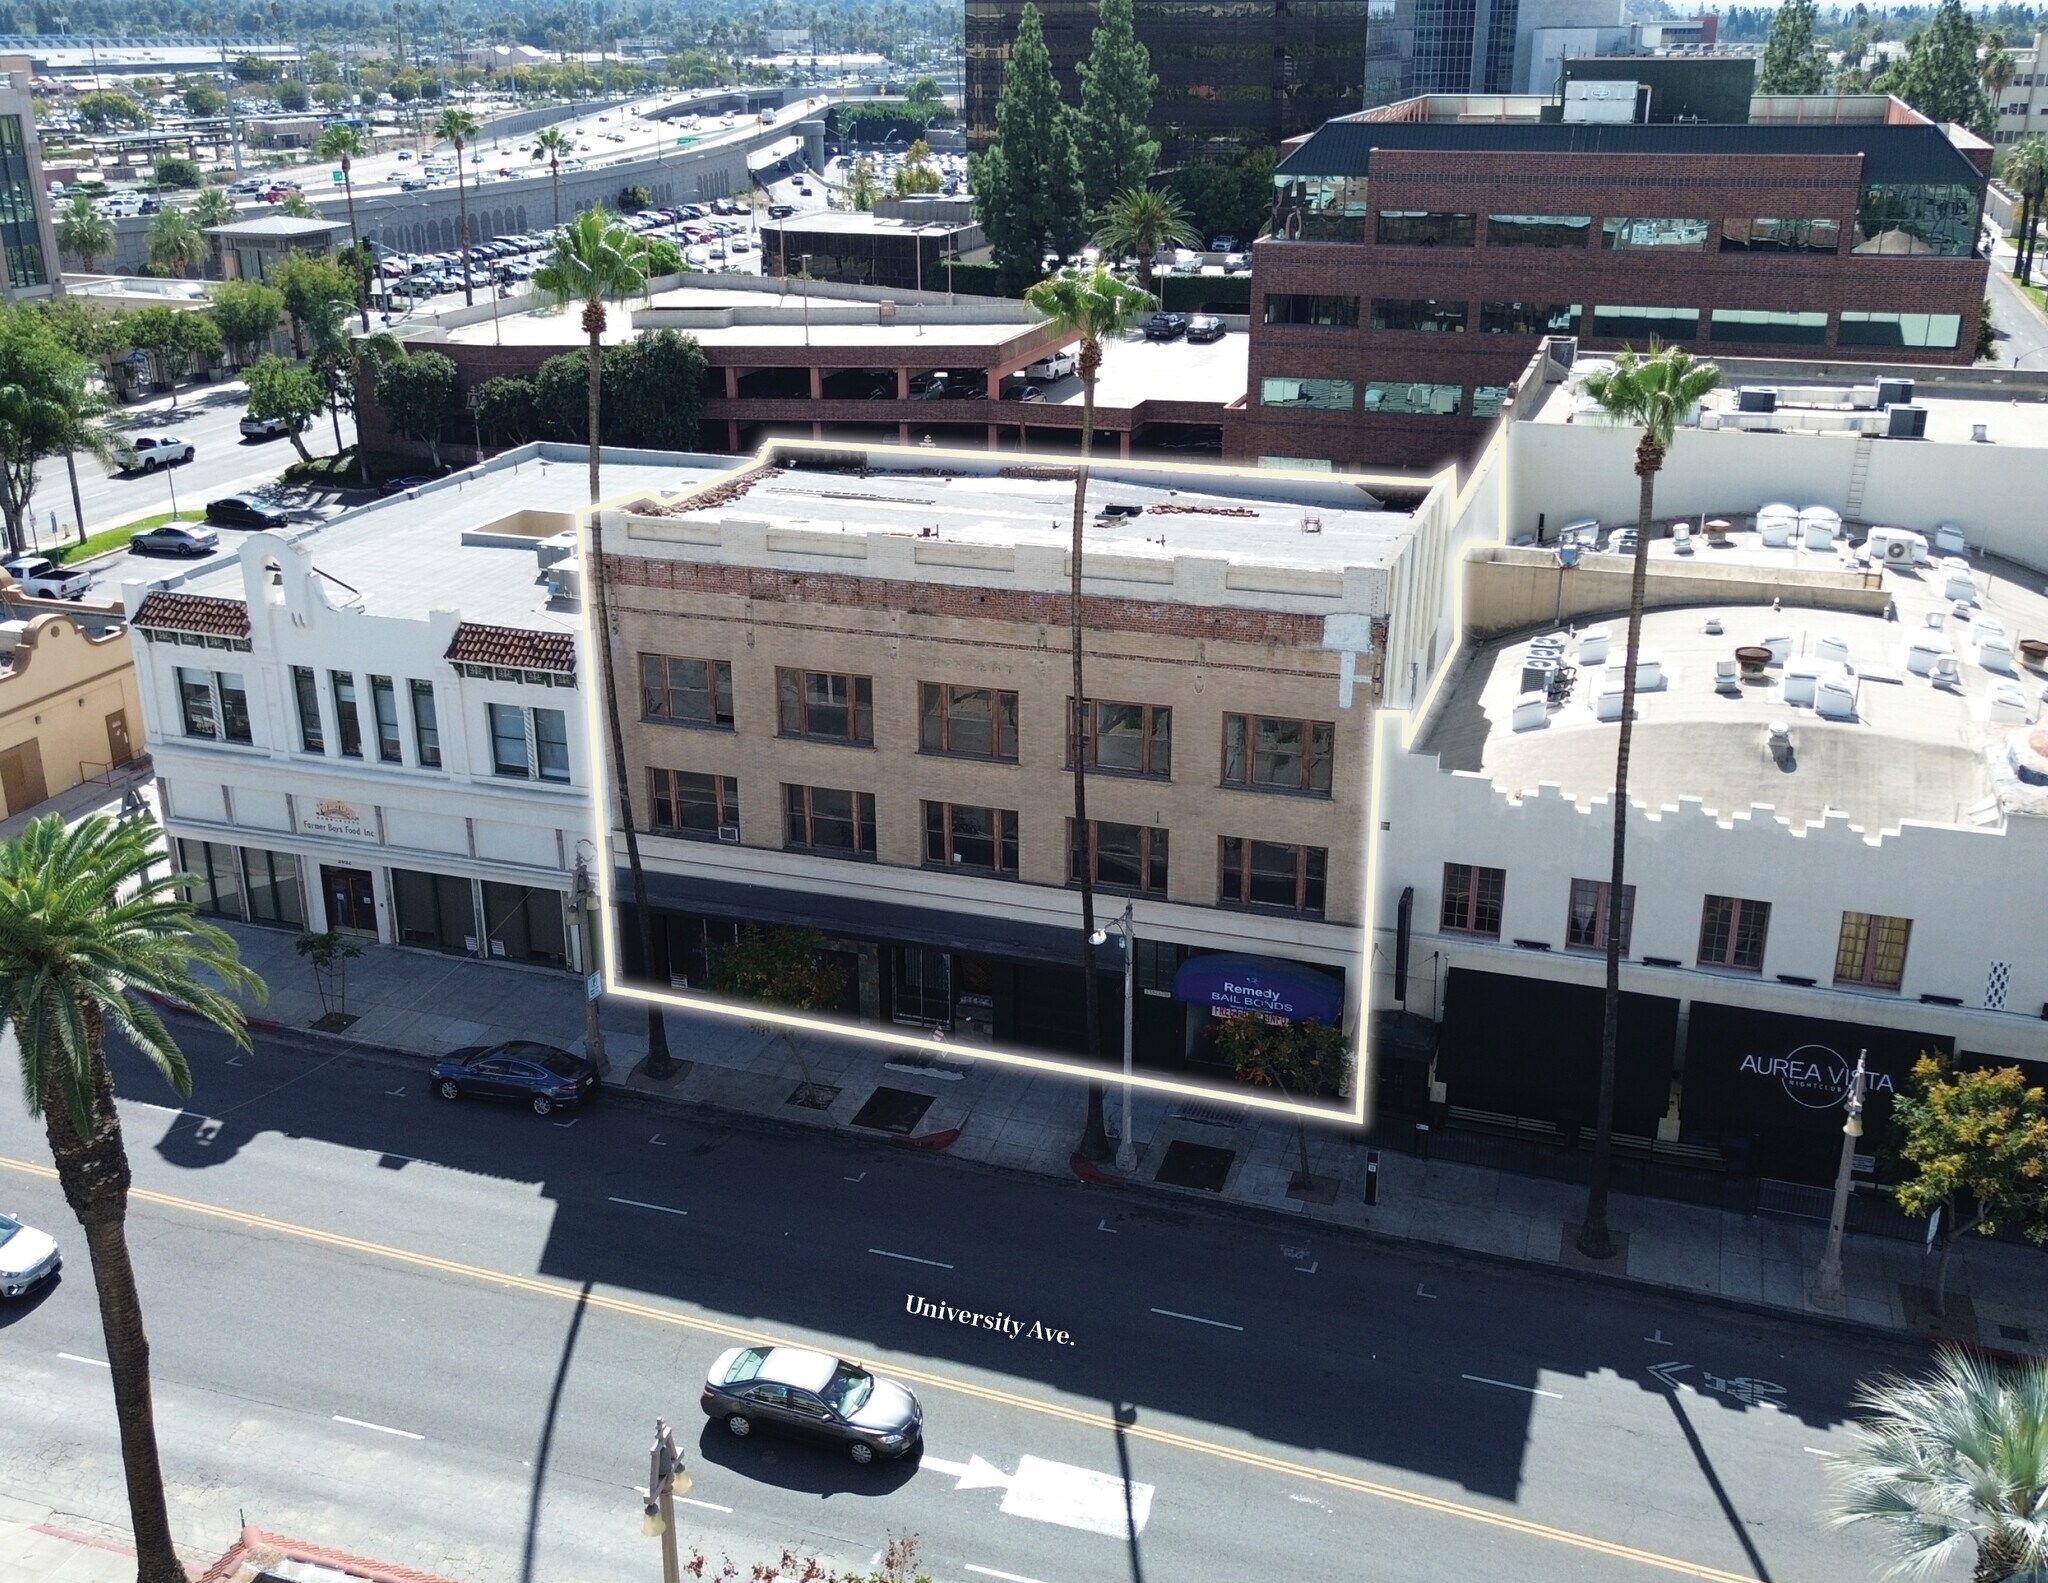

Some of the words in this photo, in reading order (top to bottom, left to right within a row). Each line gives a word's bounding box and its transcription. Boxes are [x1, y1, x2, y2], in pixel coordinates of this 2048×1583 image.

[303, 820, 326, 831] Farmer
[328, 823, 343, 833] Boys
[345, 826, 361, 836] Food
[1224, 982, 1280, 1001] Remedy
[1211, 992, 1241, 1004] BAIL
[1244, 997, 1294, 1012] BONDS
[1740, 1054, 1822, 1082] AUREA
[1788, 1080, 1842, 1093] NIGHTCLUB
